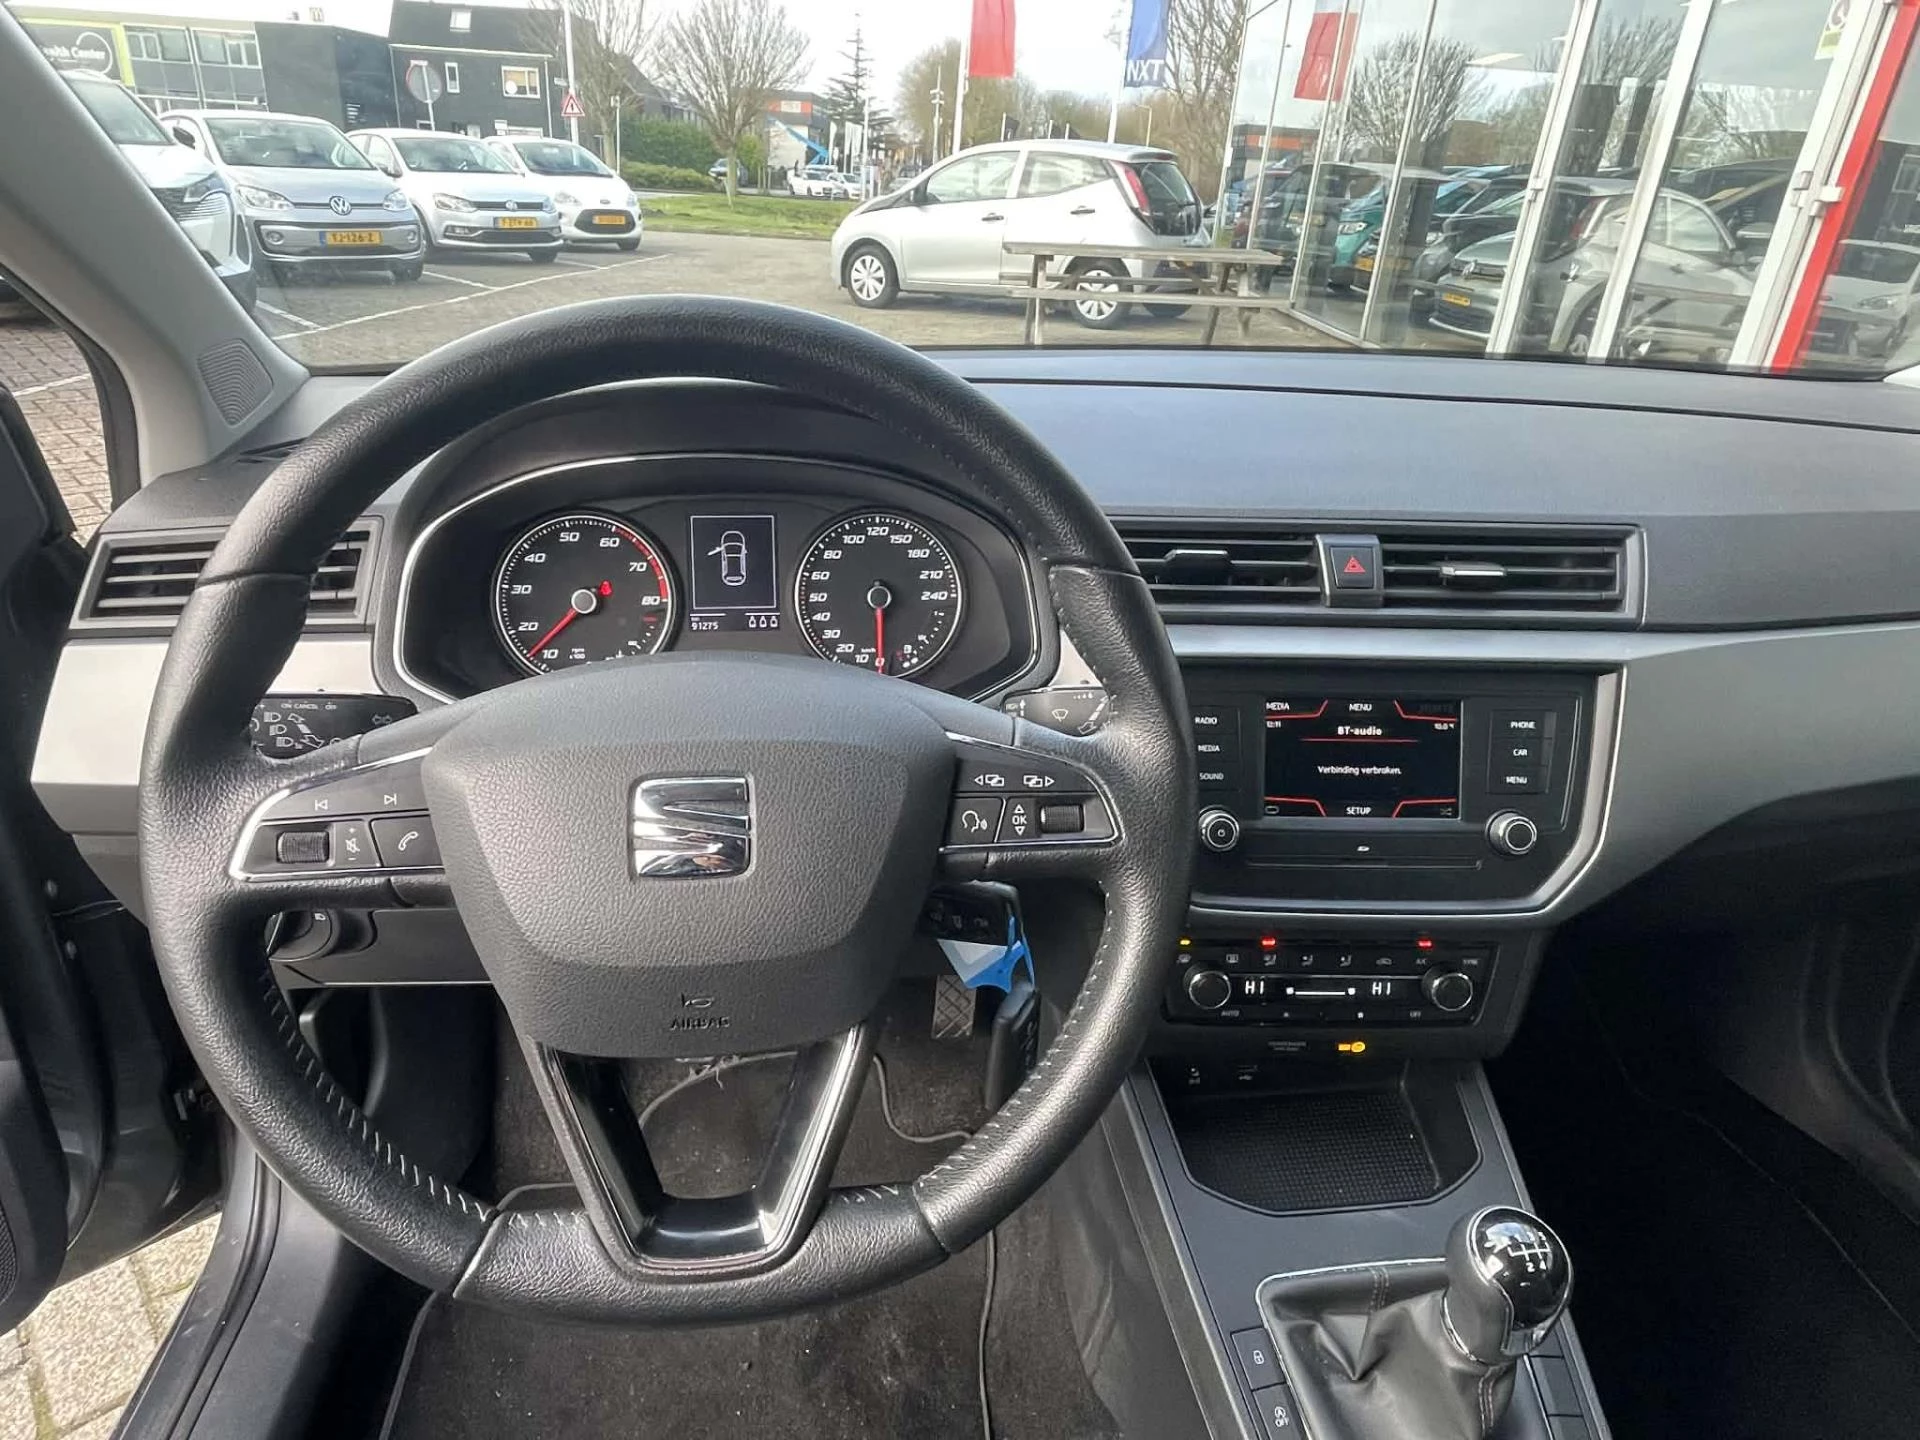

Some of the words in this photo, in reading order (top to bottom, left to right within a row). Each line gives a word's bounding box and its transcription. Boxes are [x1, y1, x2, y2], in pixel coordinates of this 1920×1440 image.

[71, 46, 106, 59] Center
[1126, 59, 1164, 81] NXT
[866, 527, 889, 536] 120
[559, 532, 580, 542] 50
[842, 535, 865, 544] 100
[890, 535, 912, 544] 150
[599, 537, 620, 548] 60
[524, 552, 546, 563] 40
[823, 550, 843, 560] 80
[907, 549, 930, 559] 180
[629, 562, 647, 572] 70
[811, 571, 831, 581] 60
[919, 570, 944, 579] 210
[510, 584, 532, 595] 30
[641, 596, 661, 606] 80
[809, 593, 828, 602] 50
[920, 591, 948, 601] 240
[812, 612, 831, 622] 40
[518, 621, 539, 632] 20
[691, 621, 719, 630] 91275
[822, 630, 841, 639] 30
[836, 643, 855, 653] 20
[542, 649, 559, 659] 10
[854, 654, 870, 664] 10
[875, 657, 885, 667] 0
[1266, 702, 1290, 710] MEDIA
[1349, 703, 1373, 711] MENU
[1510, 721, 1536, 729] PHONE
[1337, 726, 1382, 736] BT-audio
[1513, 748, 1528, 756] CAR
[1317, 766, 1359, 776] Verbinding
[1506, 776, 1528, 784] MENU
[1346, 807, 1371, 815] SETUP
[1012, 815, 1027, 825] OK
[1244, 980, 1265, 995] HI
[1371, 981, 1392, 996] HI
[670, 1016, 731, 1030] AIRBAG
[1525, 1262, 1535, 1273] 2
